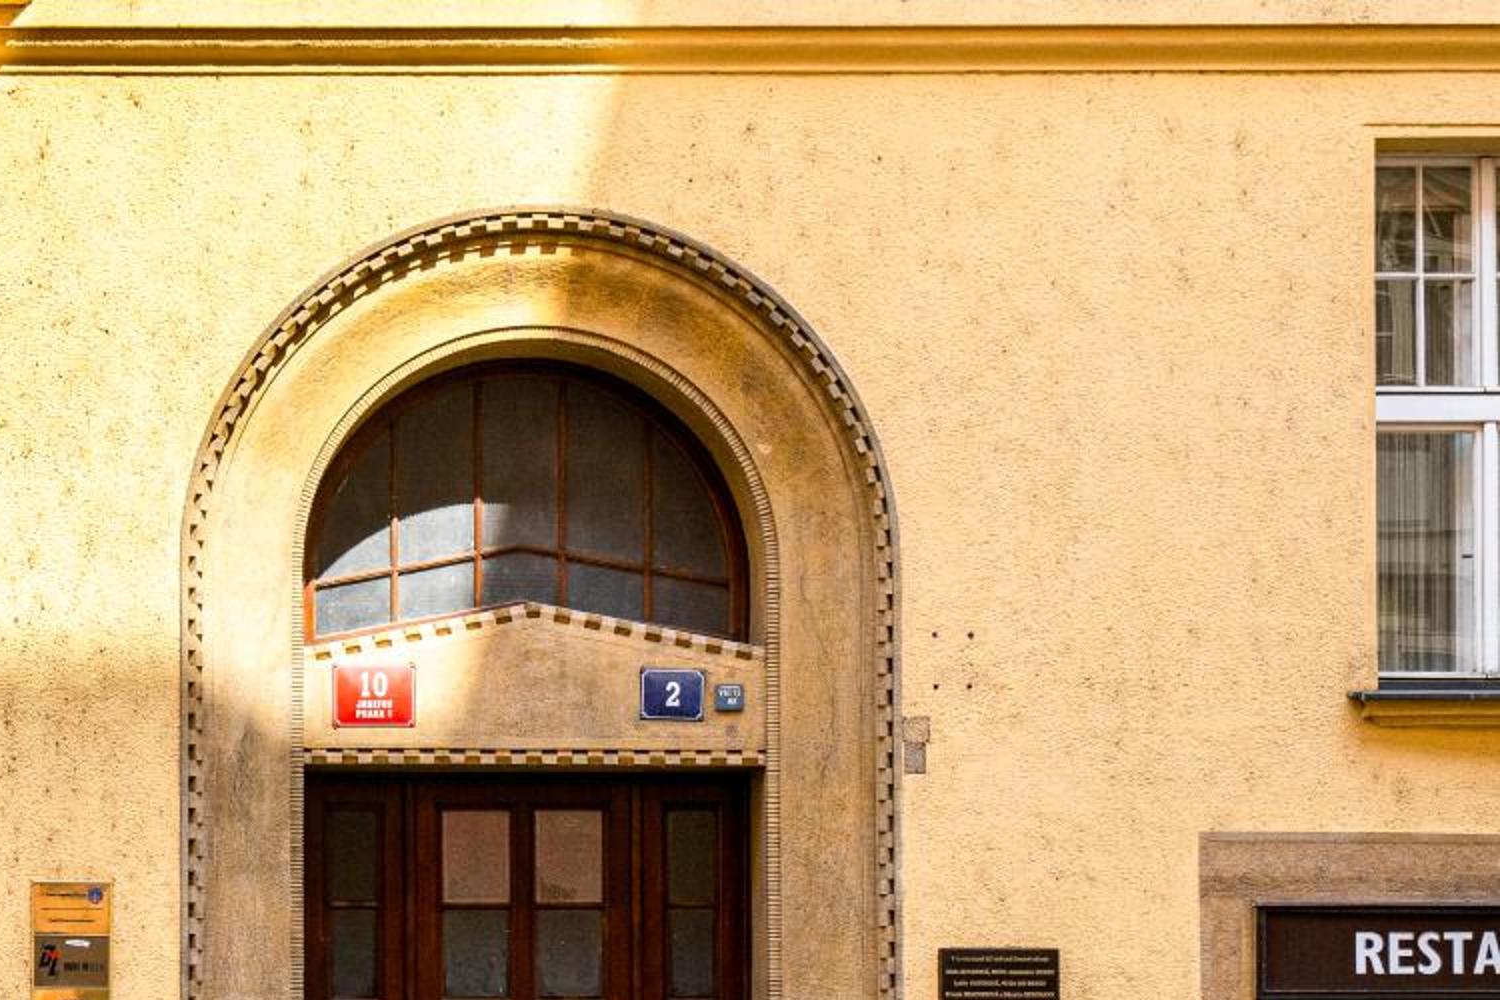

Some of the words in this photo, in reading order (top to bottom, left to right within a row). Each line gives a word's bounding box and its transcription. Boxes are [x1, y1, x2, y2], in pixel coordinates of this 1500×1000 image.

[360, 671, 389, 697] 10
[665, 681, 681, 707] 2
[1355, 931, 1500, 975] RESTA
